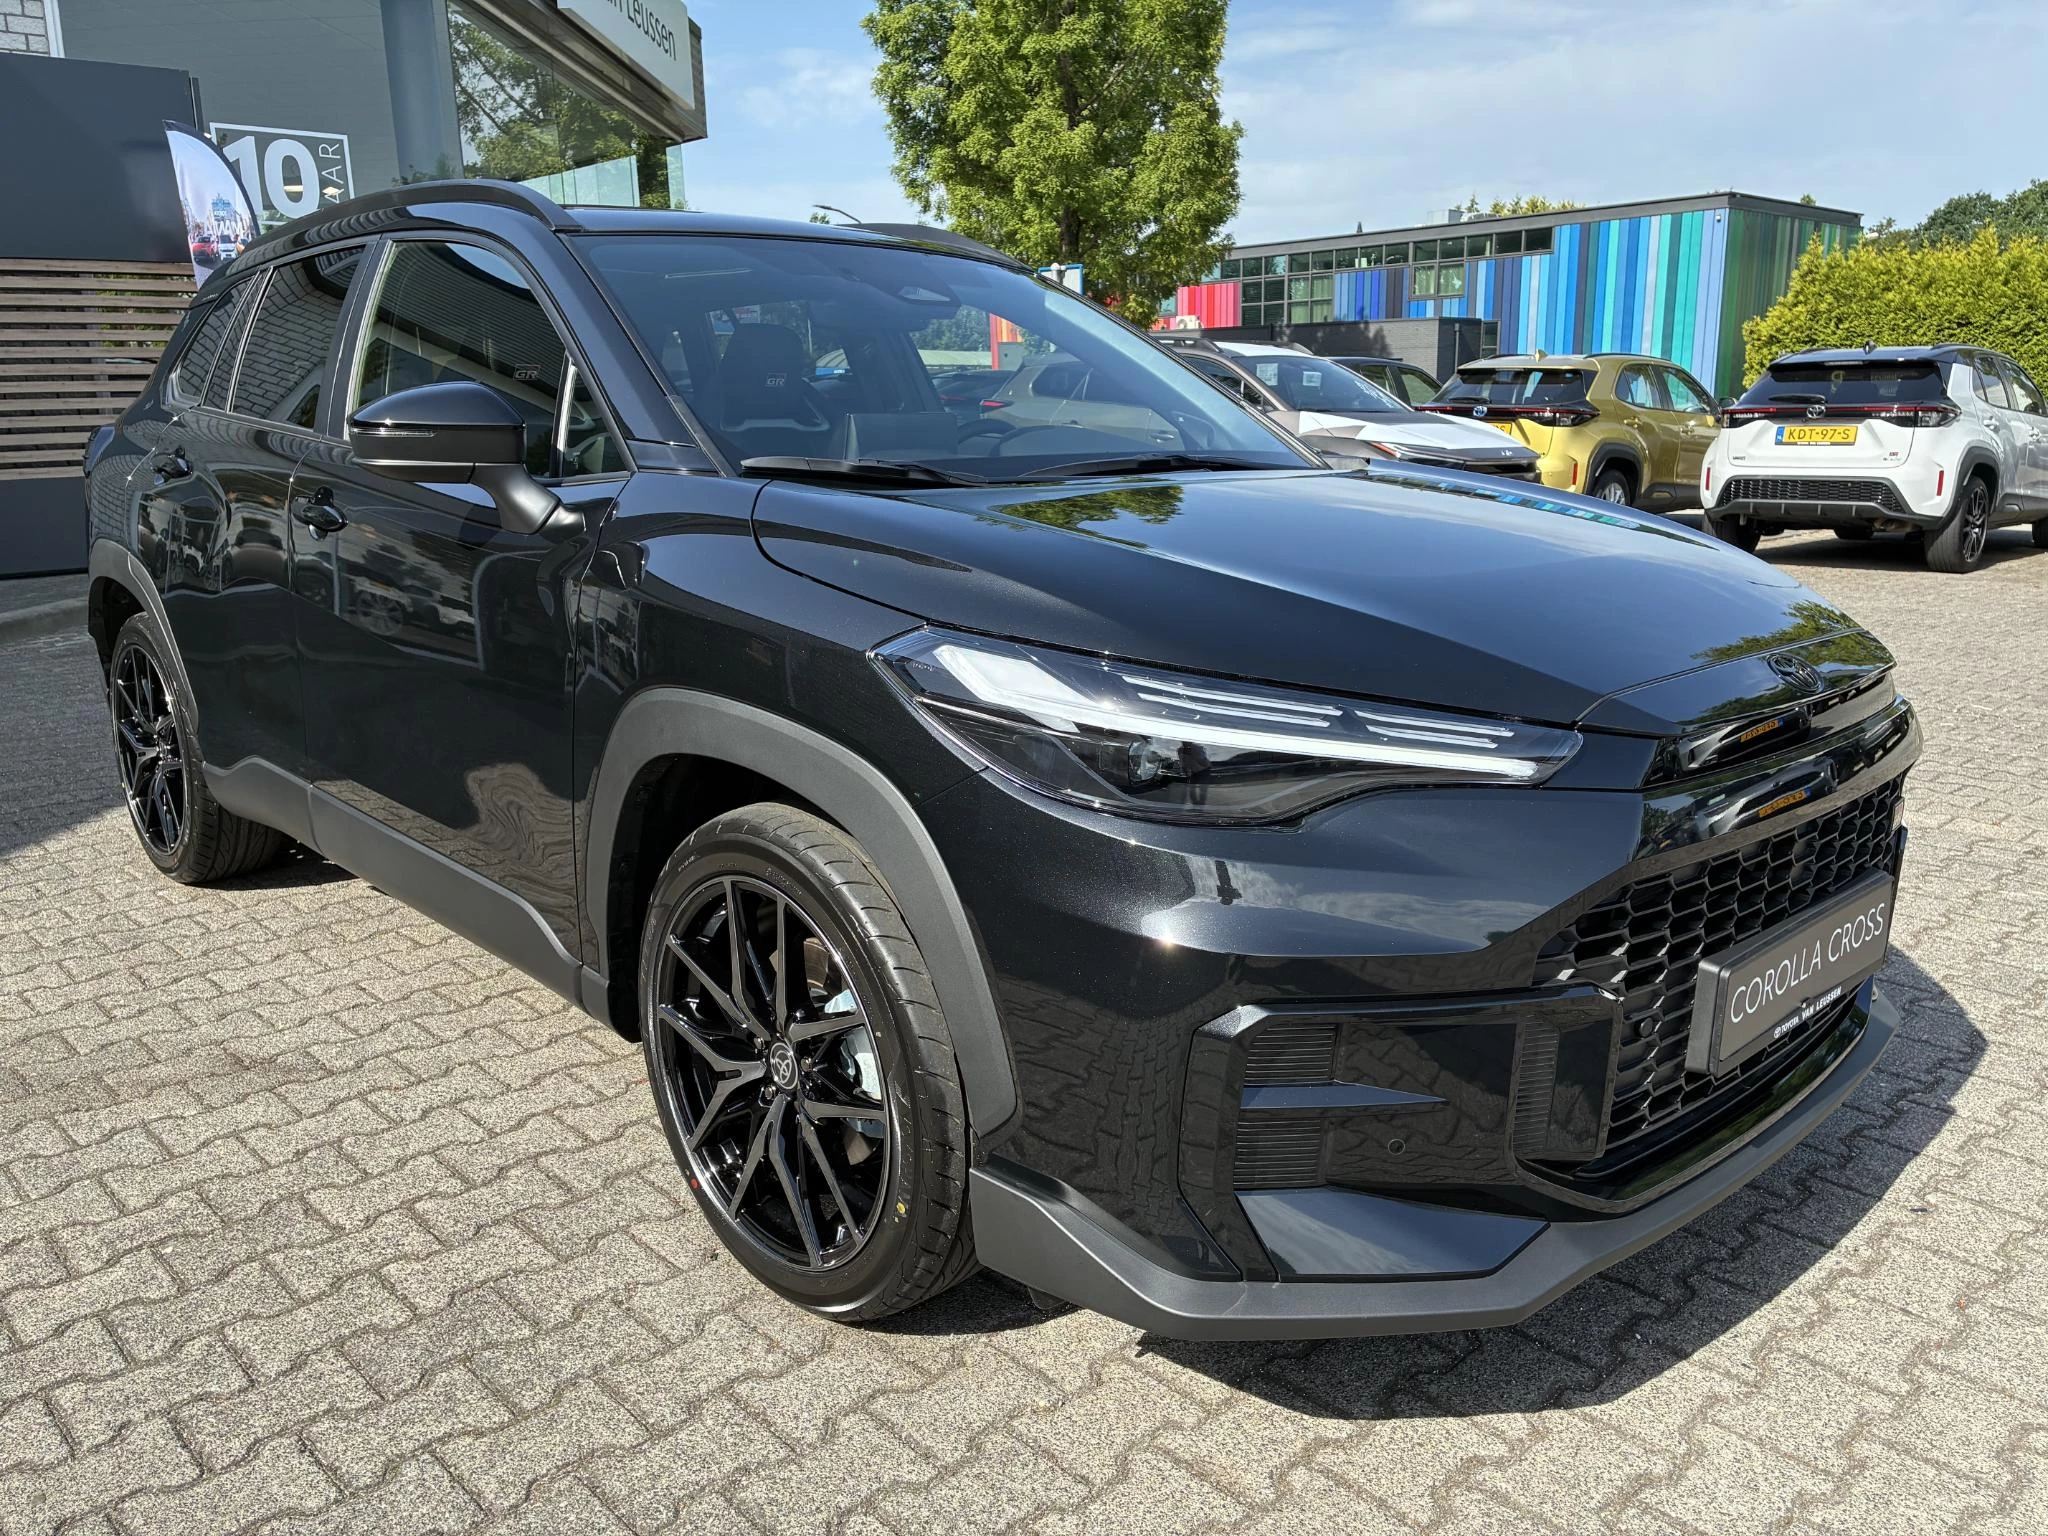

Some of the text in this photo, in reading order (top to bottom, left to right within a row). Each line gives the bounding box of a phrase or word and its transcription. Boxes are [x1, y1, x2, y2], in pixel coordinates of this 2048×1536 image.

[222, 135, 320, 219] 10
[515, 370, 537, 379] GR
[767, 377, 785, 386] GR
[1788, 428, 1851, 441] KDT-97-S
[1730, 903, 1885, 1024] COROLLA CROSS
[1781, 985, 1842, 1034] TOYOTA VAN LEUSSEN
